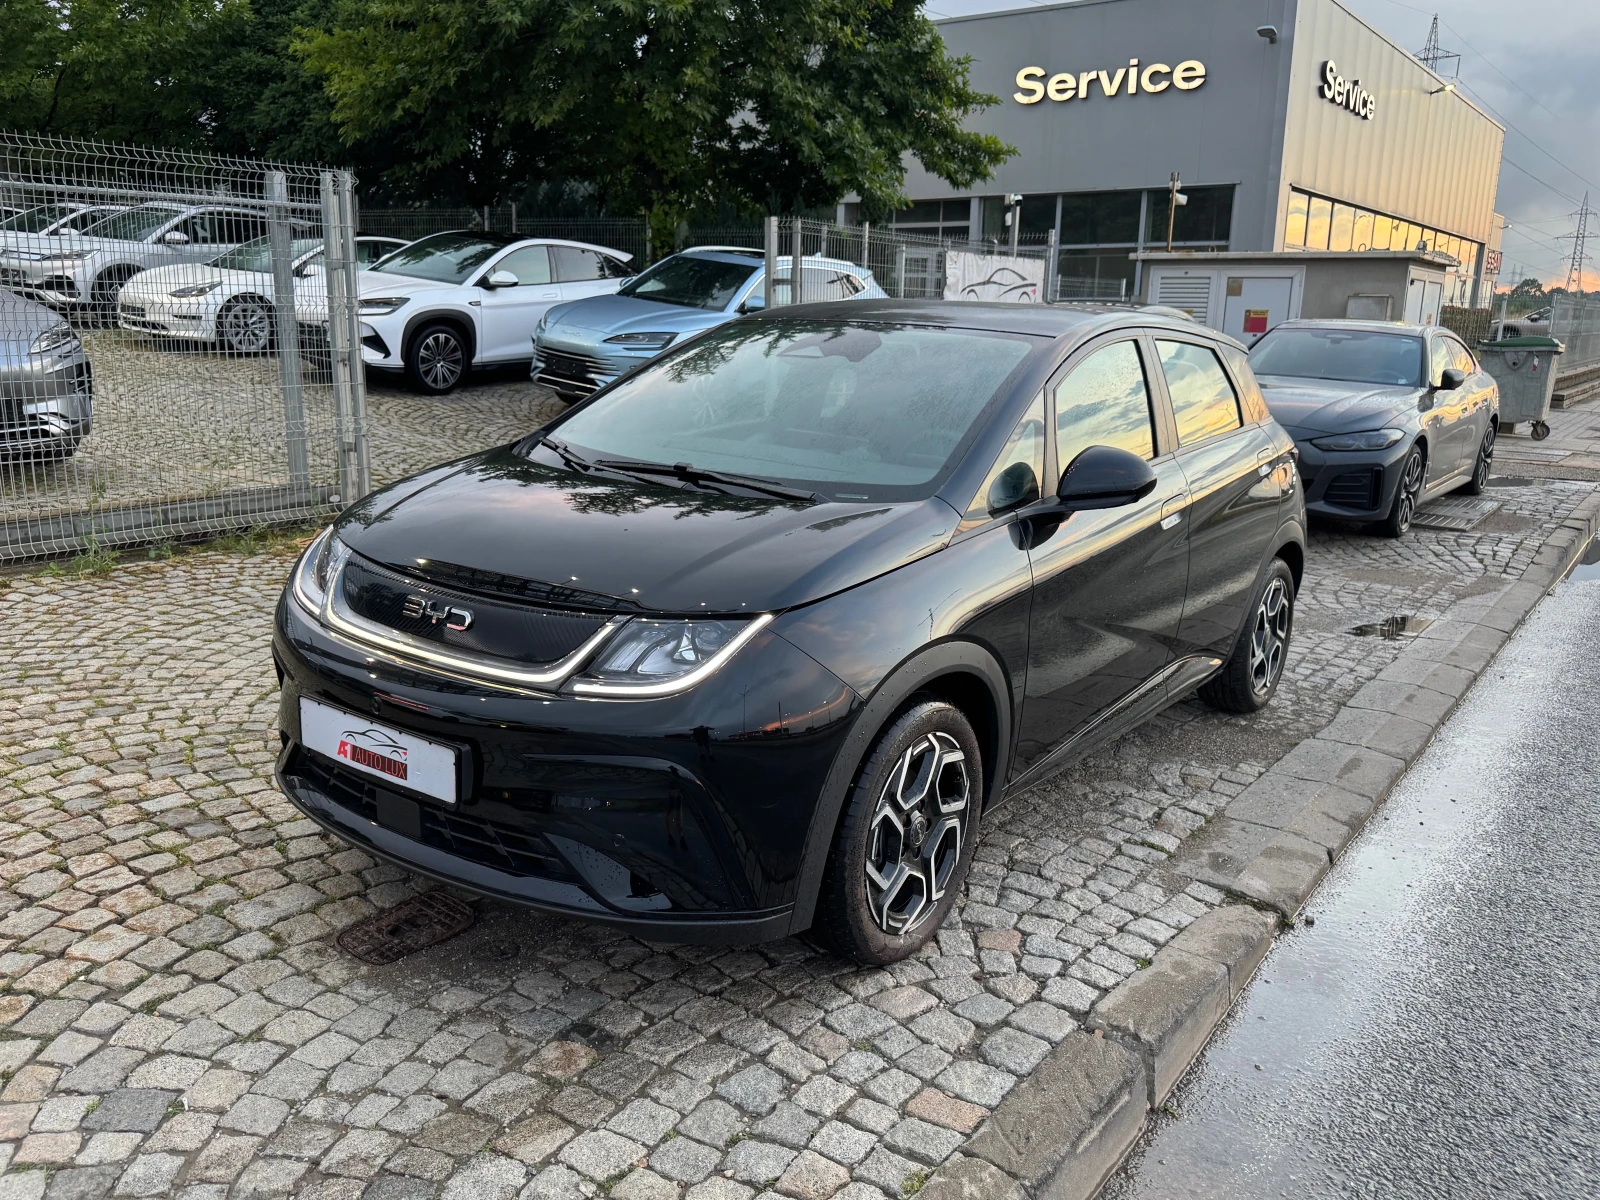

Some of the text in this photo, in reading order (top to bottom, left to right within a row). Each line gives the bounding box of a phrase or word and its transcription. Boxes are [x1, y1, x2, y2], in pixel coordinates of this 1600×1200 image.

[1013, 58, 1207, 105] Service
[1320, 59, 1375, 121] Service
[402, 595, 474, 631] BYD
[354, 747, 382, 770] AUTO
[385, 757, 406, 780] LUX
